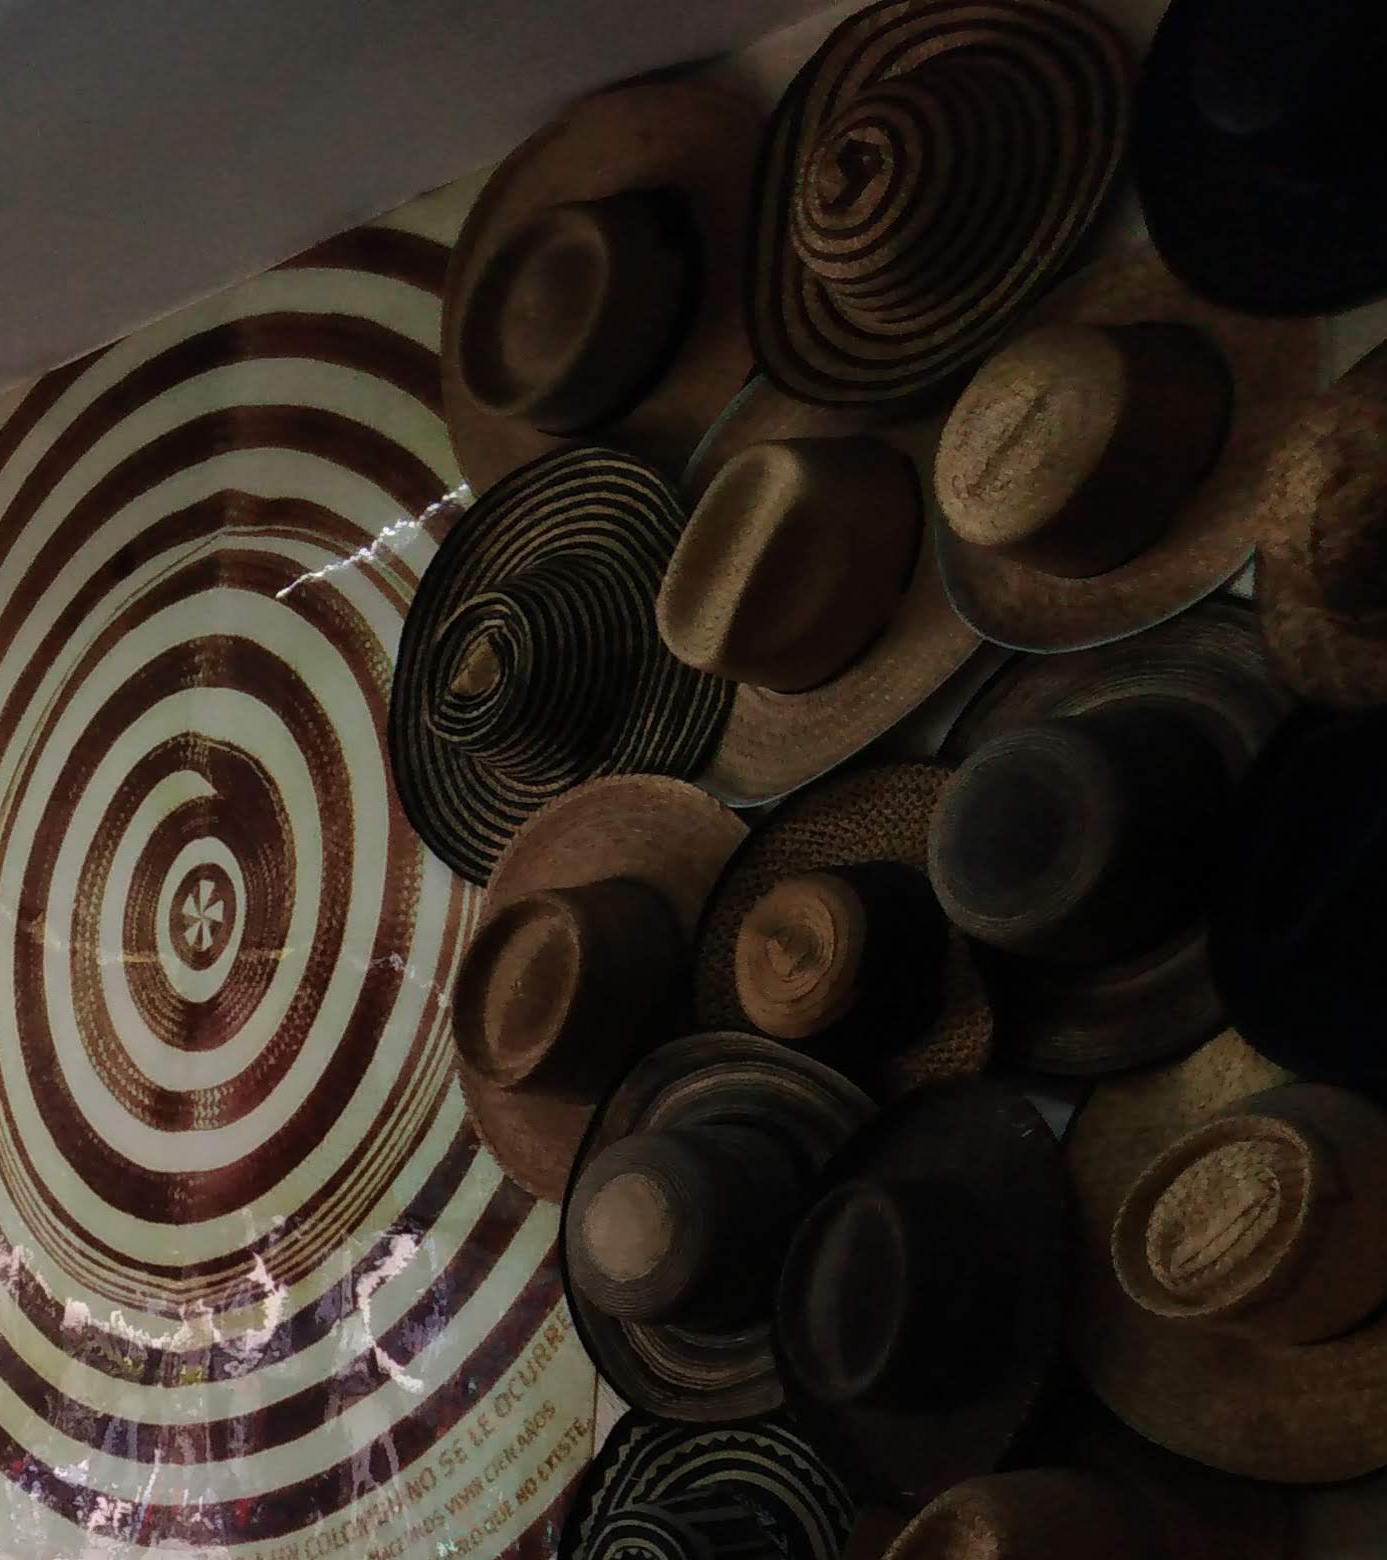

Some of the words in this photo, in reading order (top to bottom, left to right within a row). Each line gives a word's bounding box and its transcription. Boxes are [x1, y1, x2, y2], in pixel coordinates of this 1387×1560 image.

[404, 1465, 438, 1502] NO
[438, 1437, 468, 1477] SE
[493, 1308, 574, 1419] OCURRE
